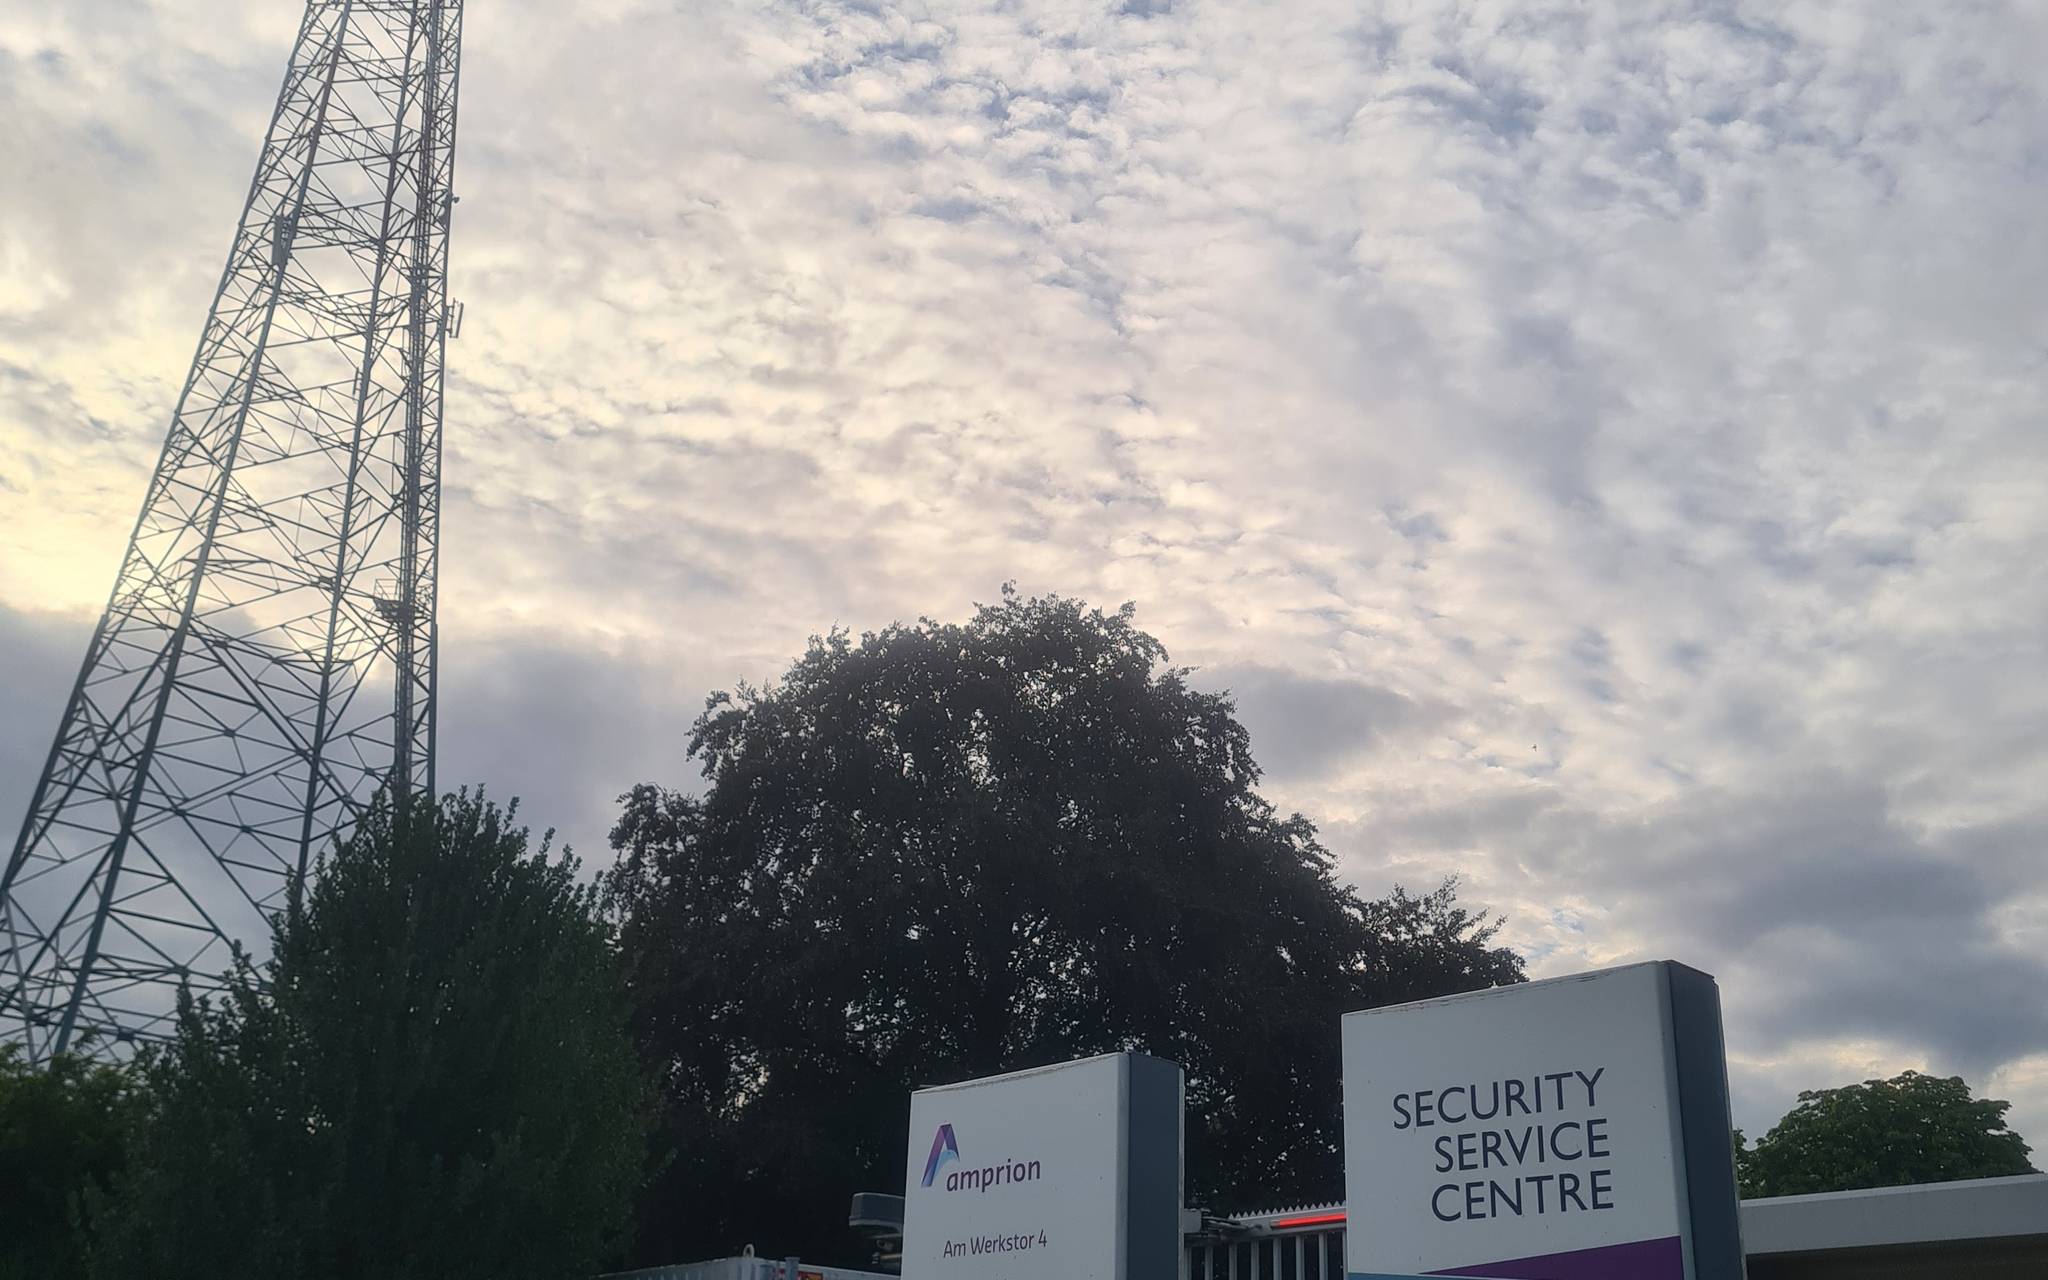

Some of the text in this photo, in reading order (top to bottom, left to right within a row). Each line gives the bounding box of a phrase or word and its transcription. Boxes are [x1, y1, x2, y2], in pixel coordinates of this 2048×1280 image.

[1393, 1067, 1605, 1130] SECURITY
[1434, 1118, 1611, 1173] SERVICE
[946, 1158, 1041, 1192] amprion
[1431, 1169, 1614, 1222] CENTRE
[943, 1229, 1048, 1258] Am Werkstor 4
